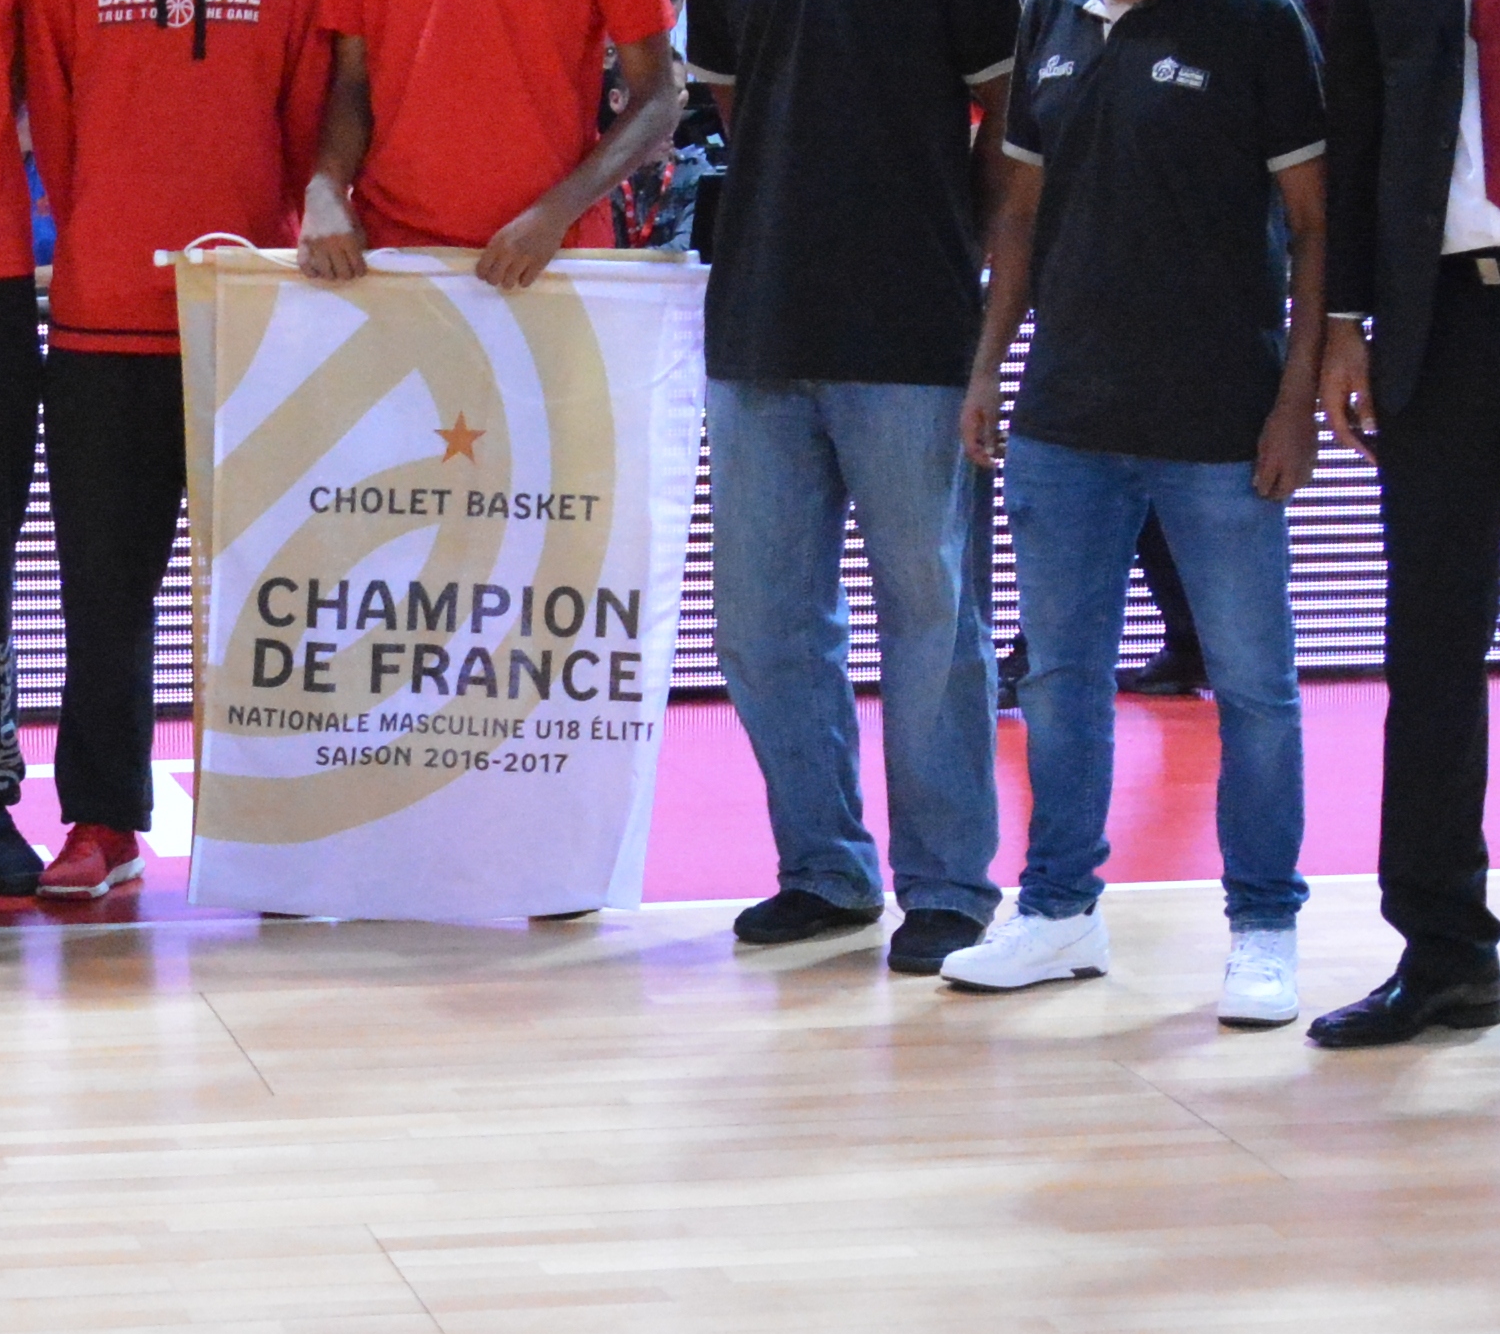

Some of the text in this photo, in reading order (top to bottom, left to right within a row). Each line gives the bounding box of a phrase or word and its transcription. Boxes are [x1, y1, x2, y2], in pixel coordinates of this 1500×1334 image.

[97, 7, 259, 23] TRUE TO HE GAME
[309, 487, 599, 522] CHOLET BASKET
[256, 576, 641, 640] CHAMPION
[252, 637, 644, 703] DE FRANCE
[227, 704, 370, 734] NATIONALE
[378, 712, 525, 739] MASCULINE
[535, 719, 581, 741] U18
[314, 745, 570, 774] SAISON 2016-2017
